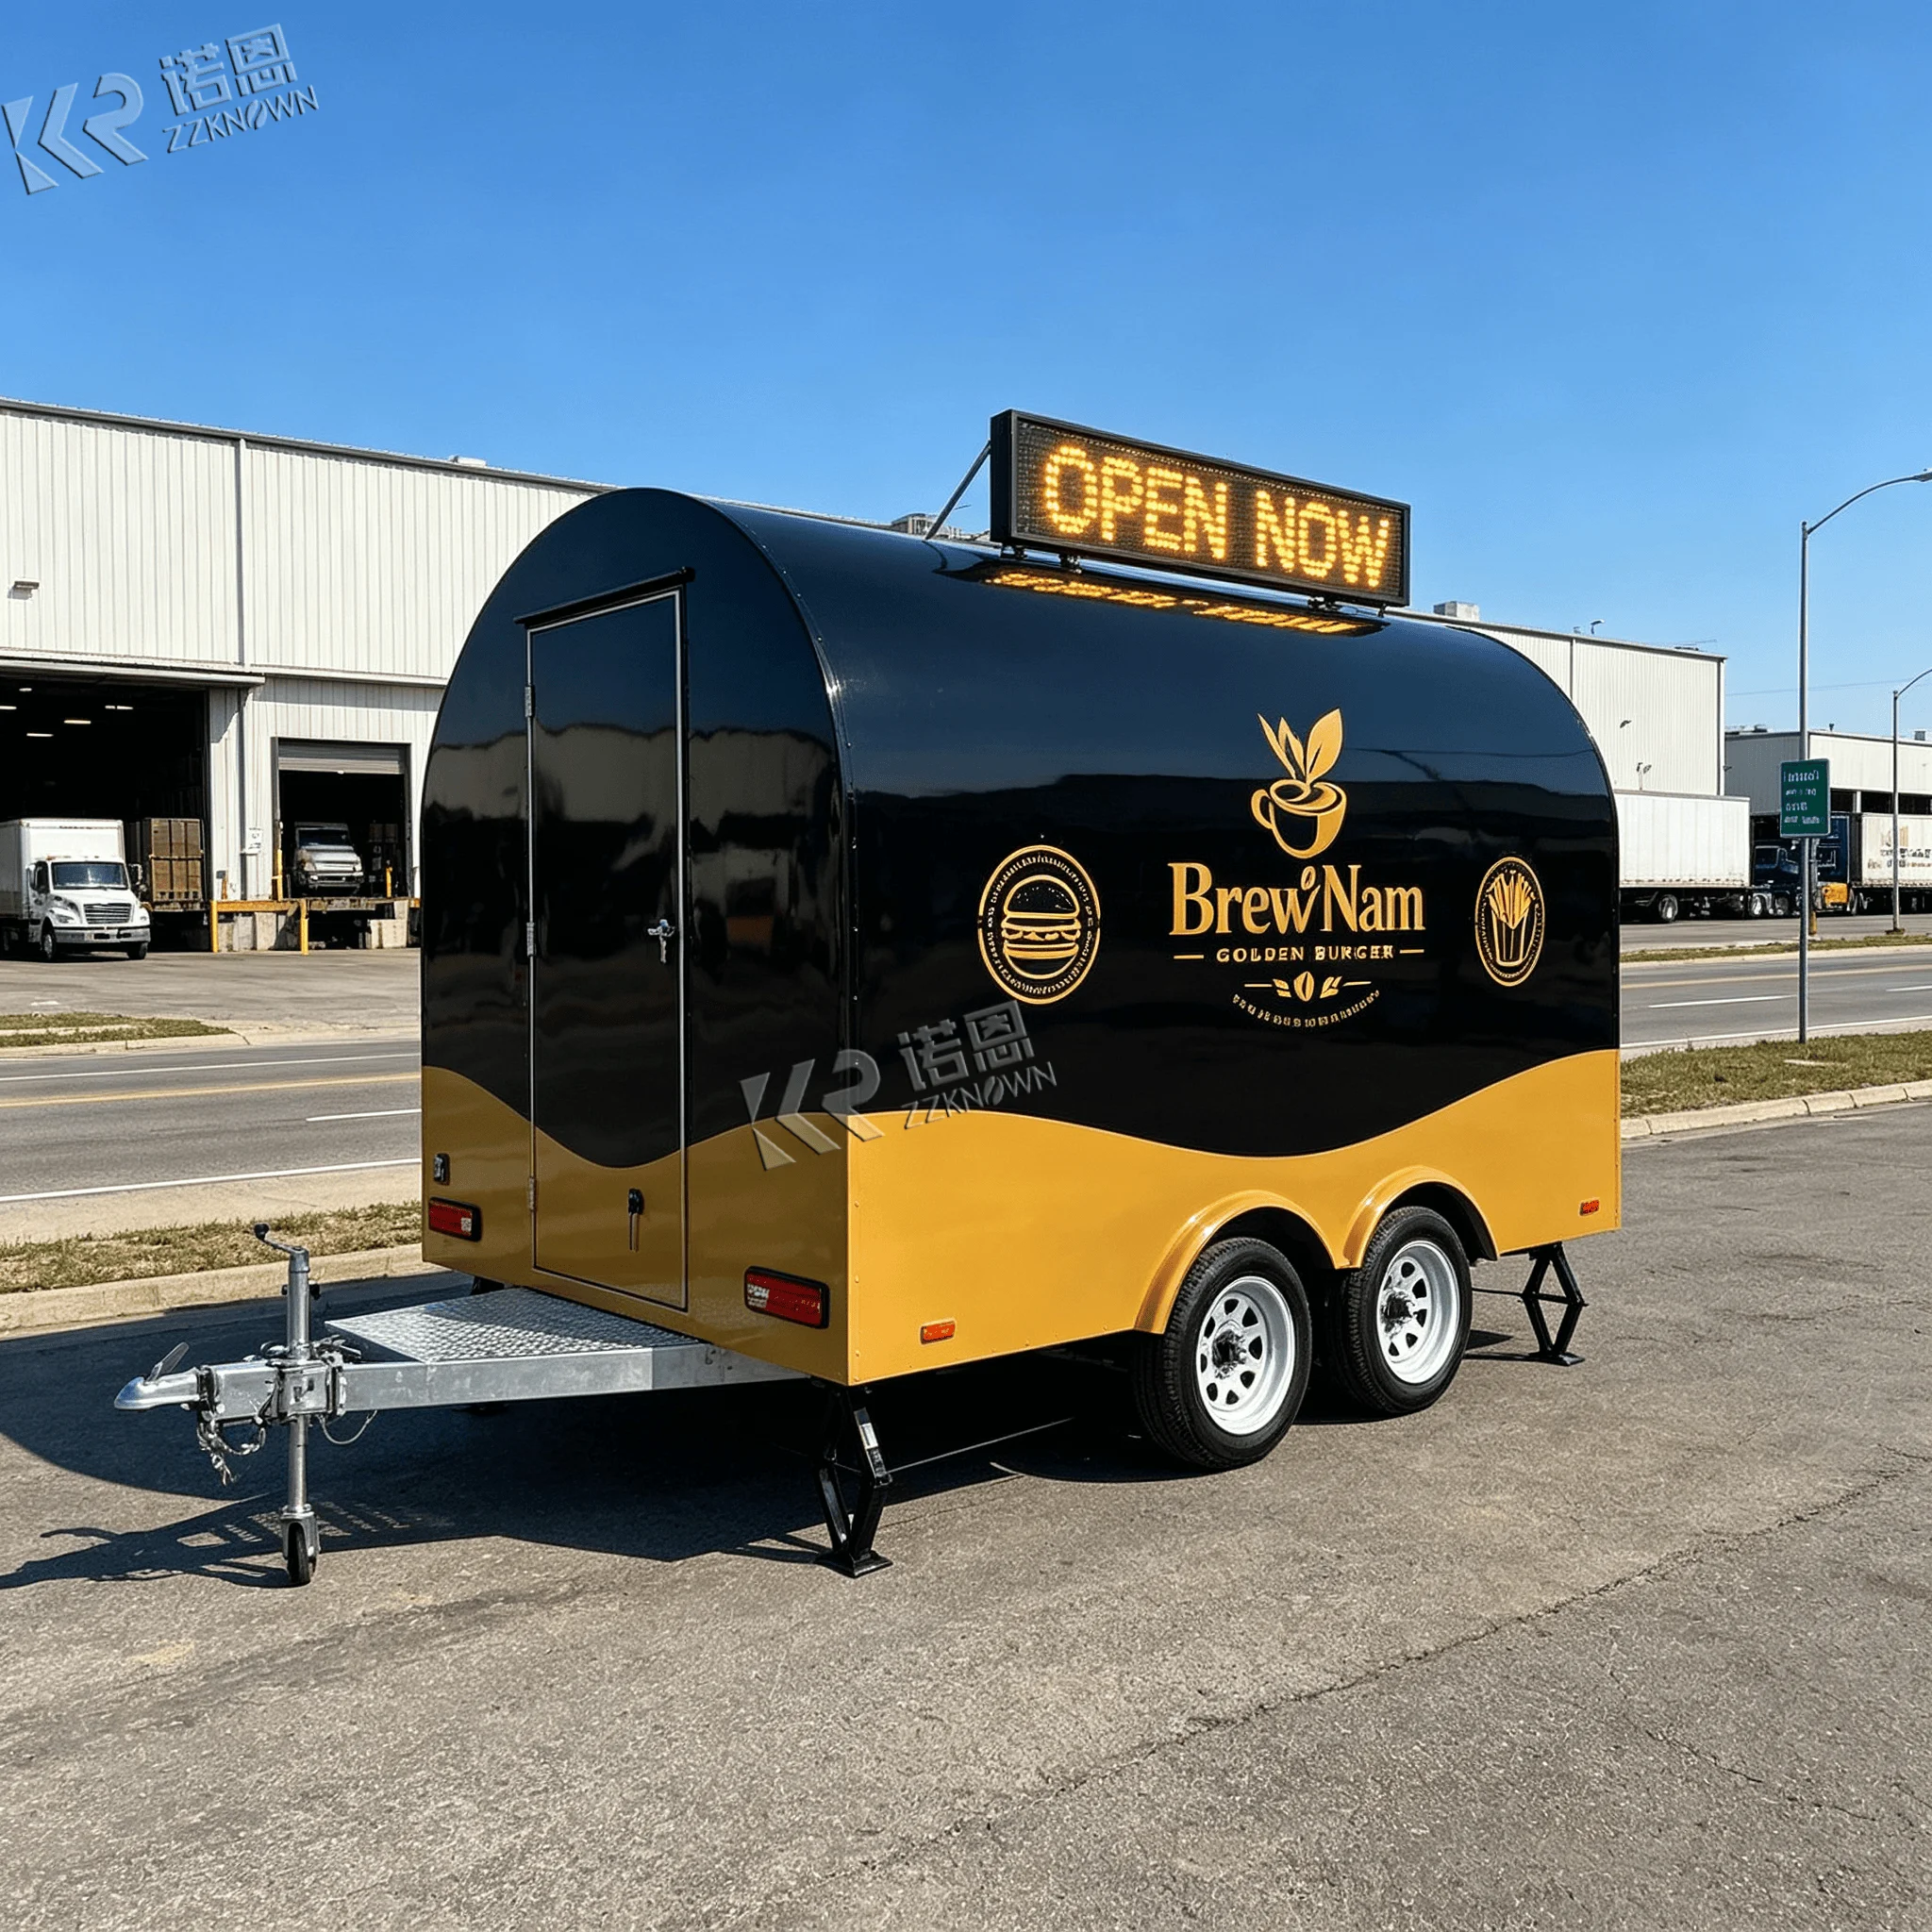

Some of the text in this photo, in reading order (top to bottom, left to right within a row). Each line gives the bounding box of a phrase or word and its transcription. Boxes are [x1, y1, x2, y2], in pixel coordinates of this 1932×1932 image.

[1045, 445, 1389, 587] OPEN NOW
[1216, 945, 1394, 963] GOLDEN BURGER
